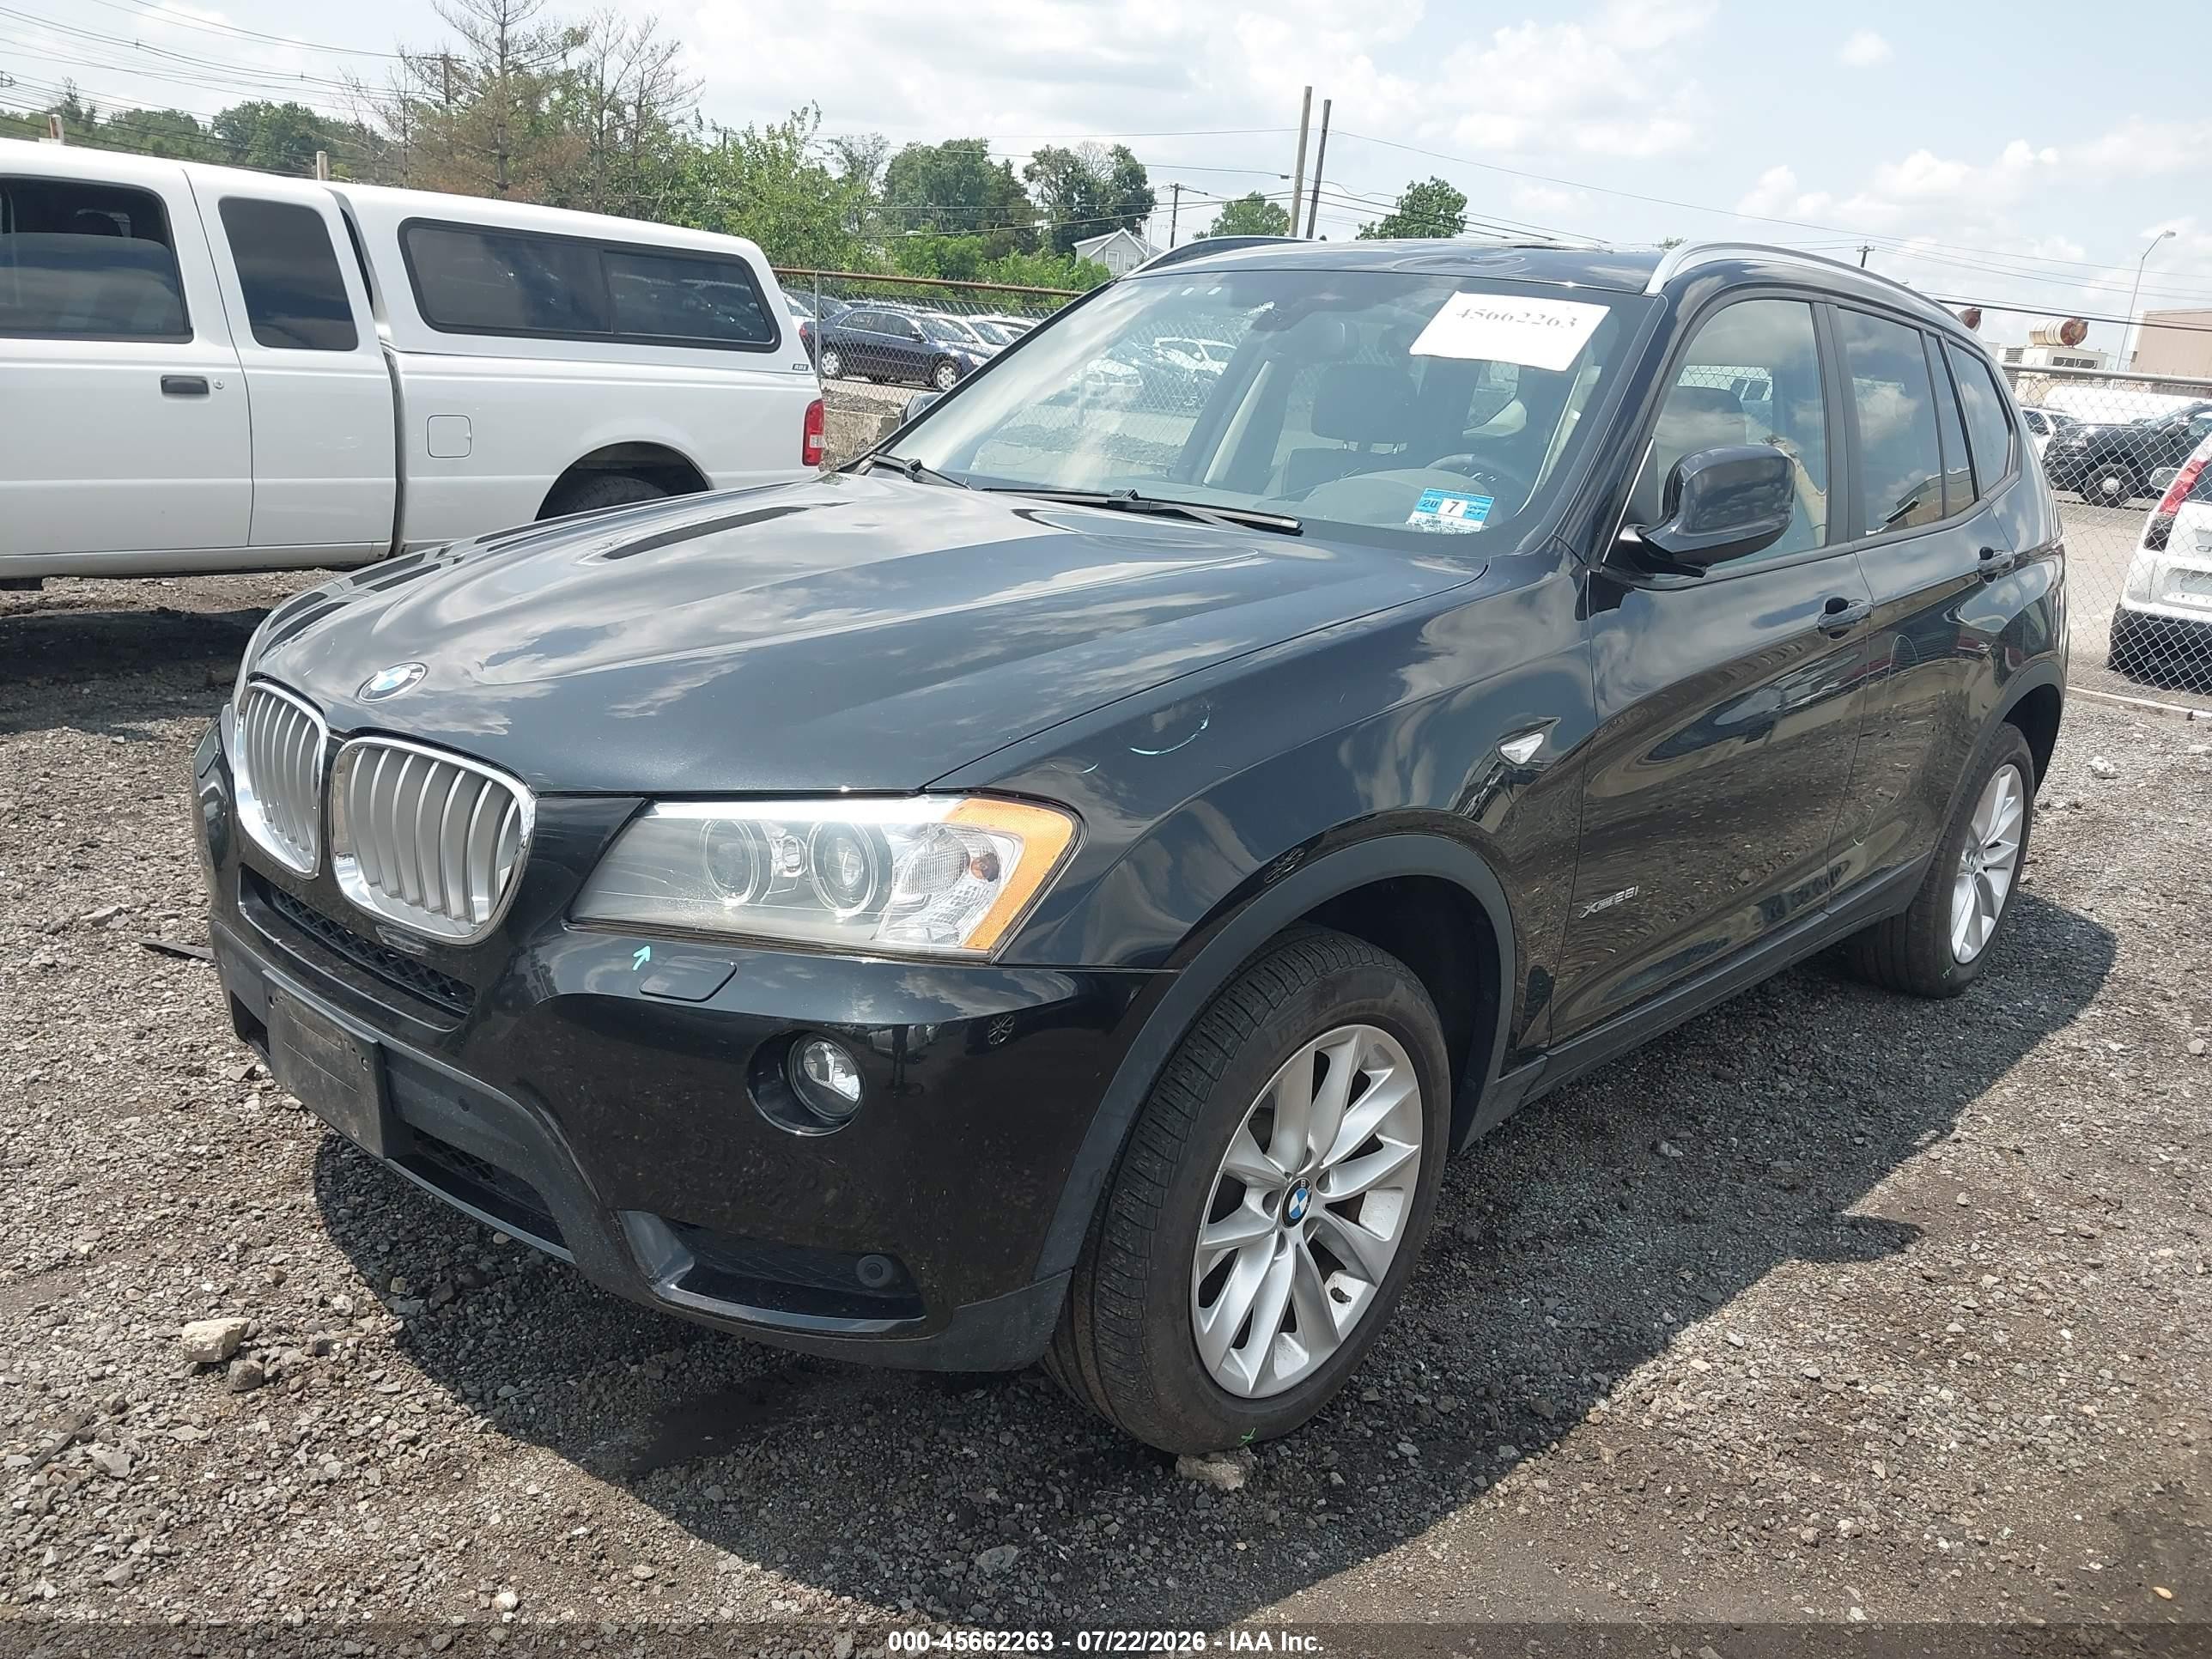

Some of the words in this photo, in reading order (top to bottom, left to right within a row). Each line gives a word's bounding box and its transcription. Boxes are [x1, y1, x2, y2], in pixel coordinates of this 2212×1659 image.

[1455, 307, 1578, 329] 45662263
[1421, 499, 1439, 508] 20
[1447, 501, 1460, 514] 7
